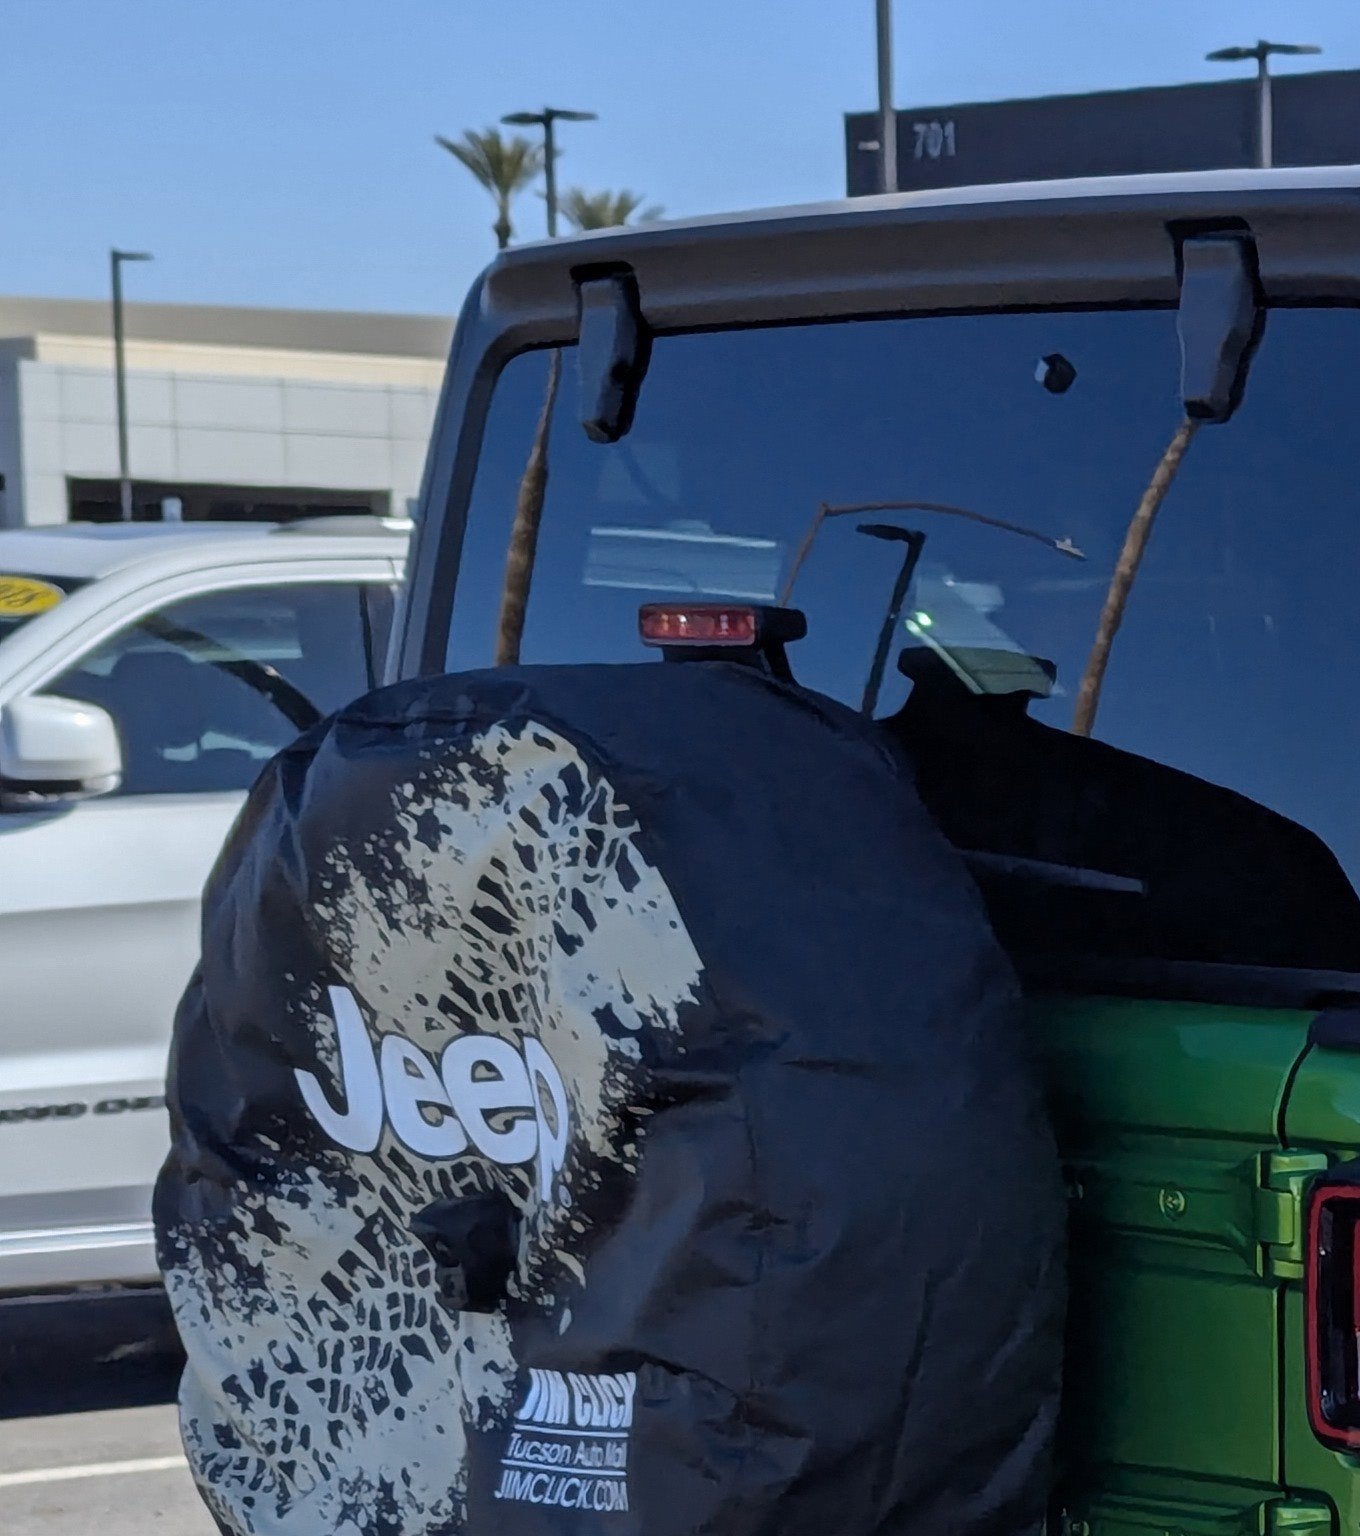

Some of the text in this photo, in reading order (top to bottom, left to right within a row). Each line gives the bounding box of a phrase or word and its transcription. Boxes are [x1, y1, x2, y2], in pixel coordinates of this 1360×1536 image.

[913, 120, 955, 158] 701
[294, 985, 570, 1202] Jeep
[514, 1368, 570, 1425] JIM
[506, 1433, 572, 1464] Tucson
[494, 1469, 629, 1512] JIMCLICK.COM
